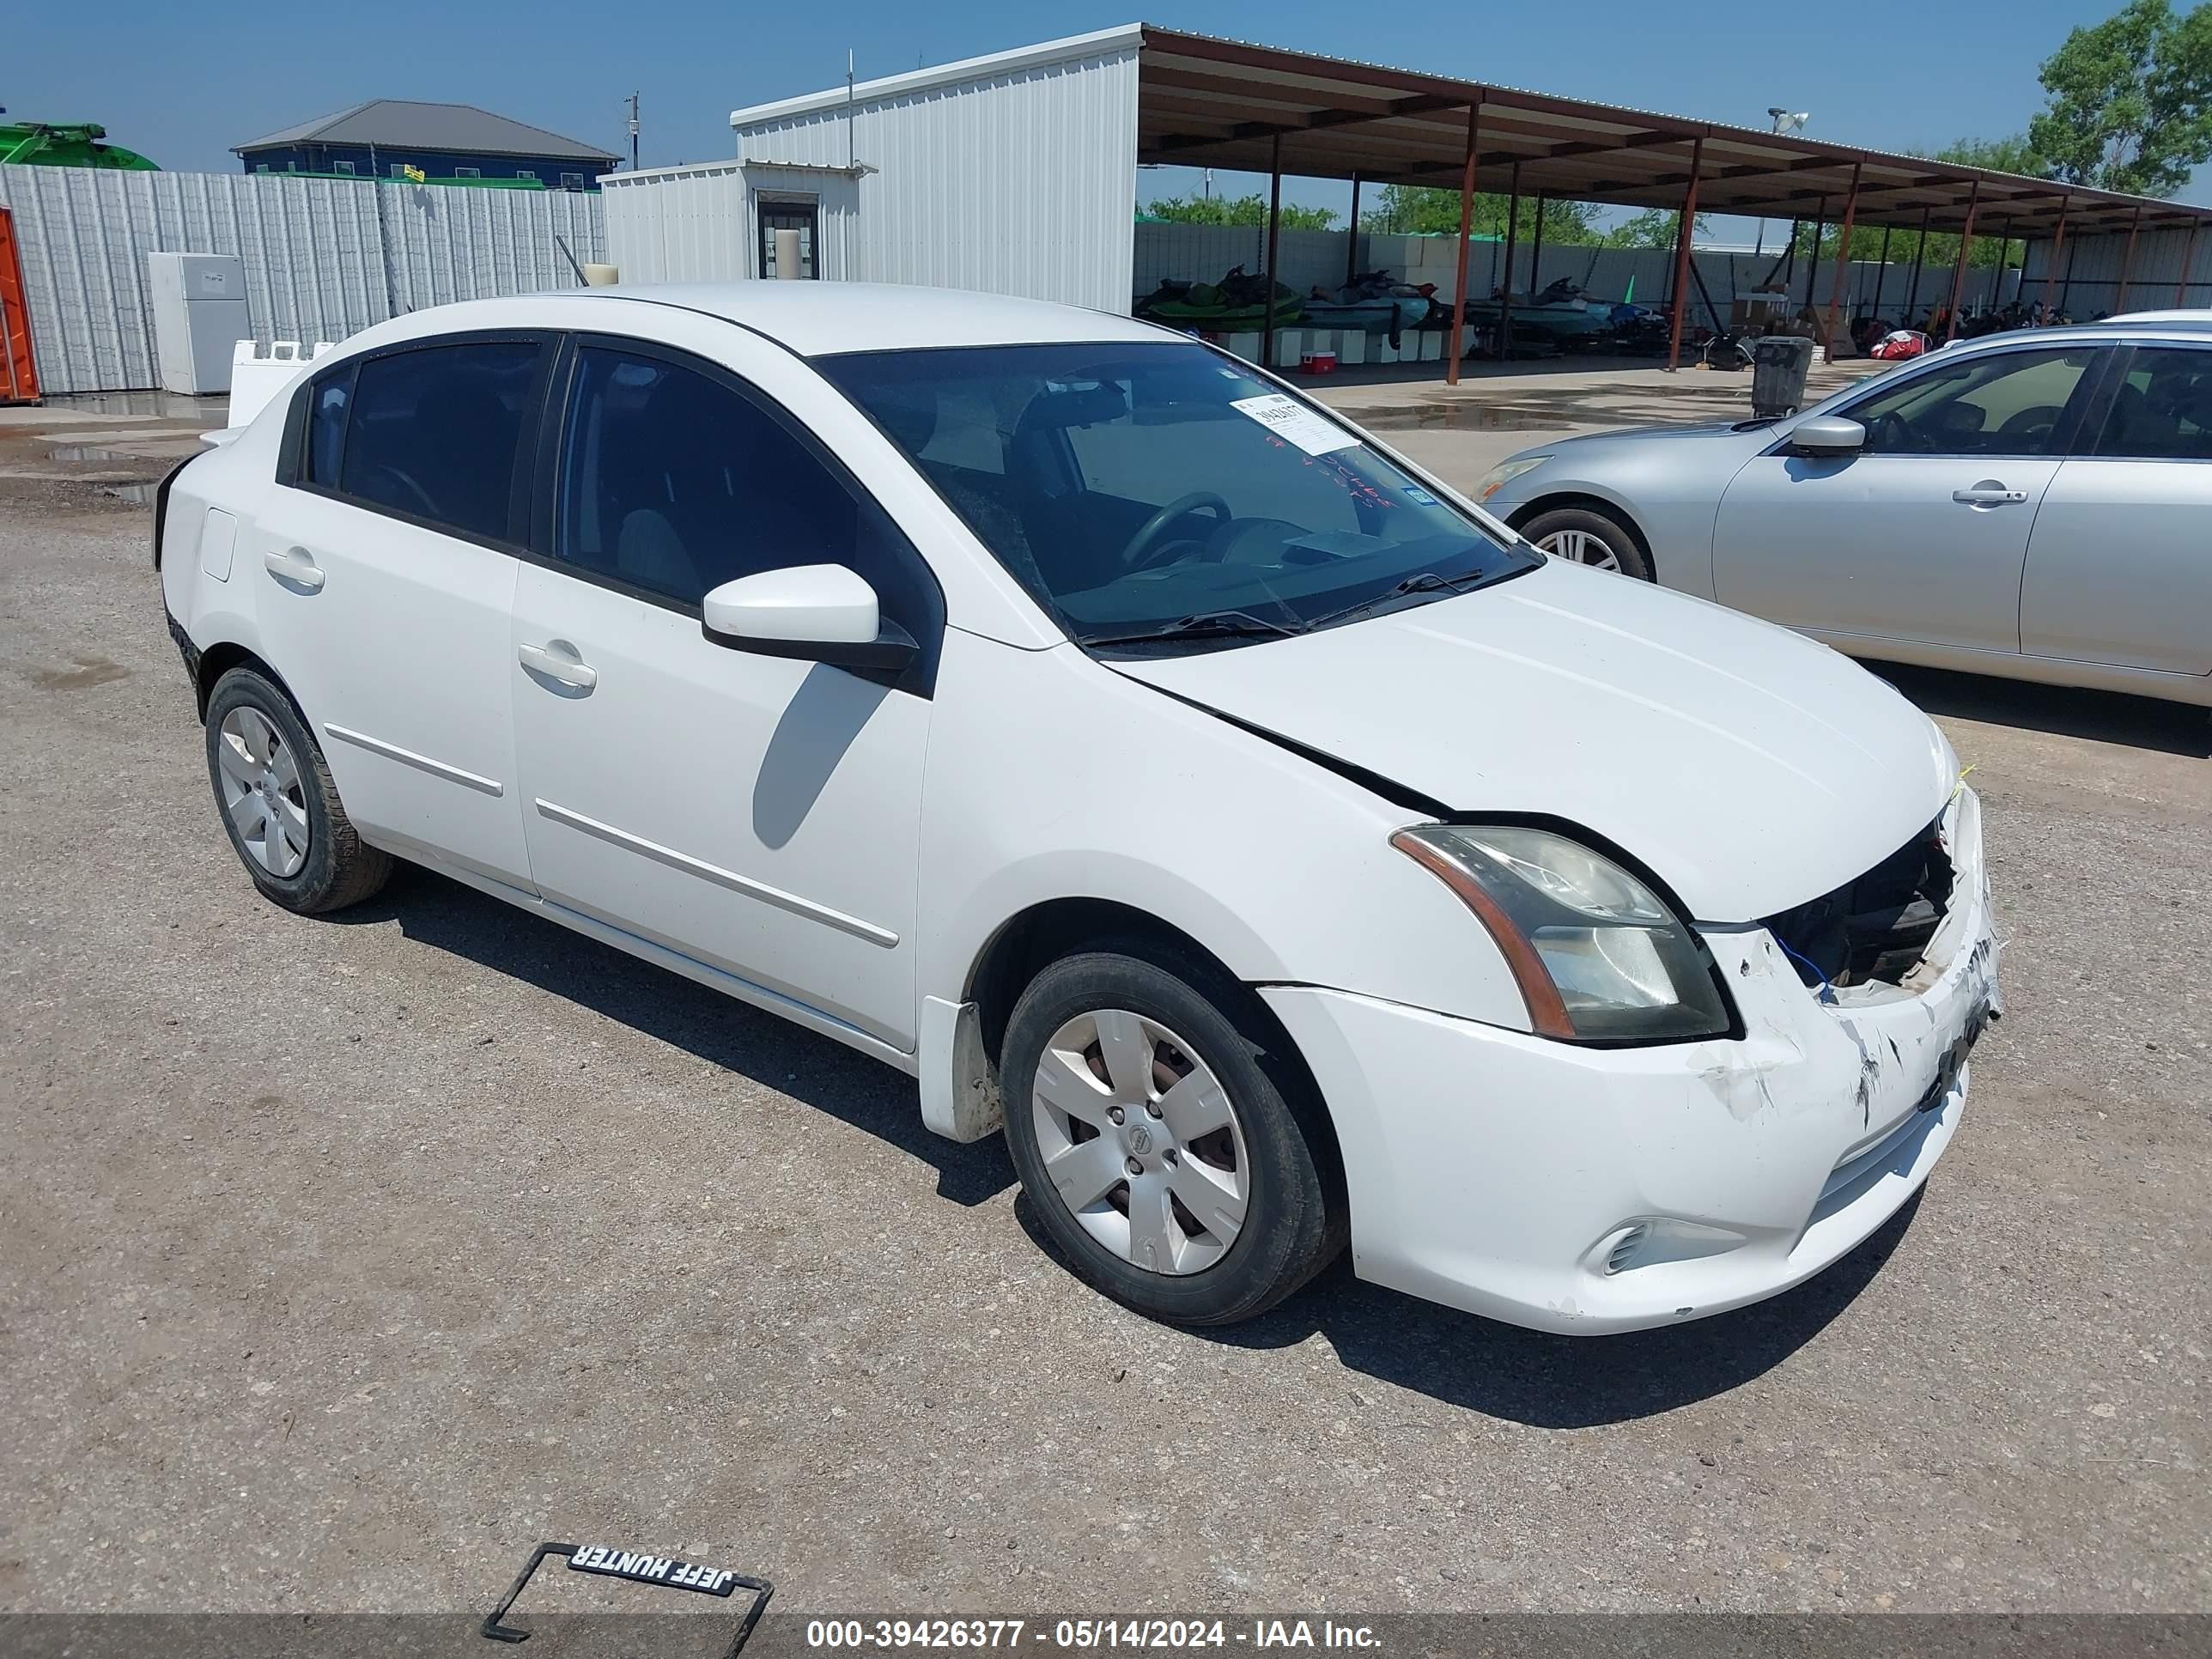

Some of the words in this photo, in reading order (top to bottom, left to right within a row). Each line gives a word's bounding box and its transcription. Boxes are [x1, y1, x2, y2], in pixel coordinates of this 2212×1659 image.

[1255, 404, 1306, 422] 39426377
[571, 1545, 673, 1579] HUNTER
[669, 1563, 732, 1589] JEFF
